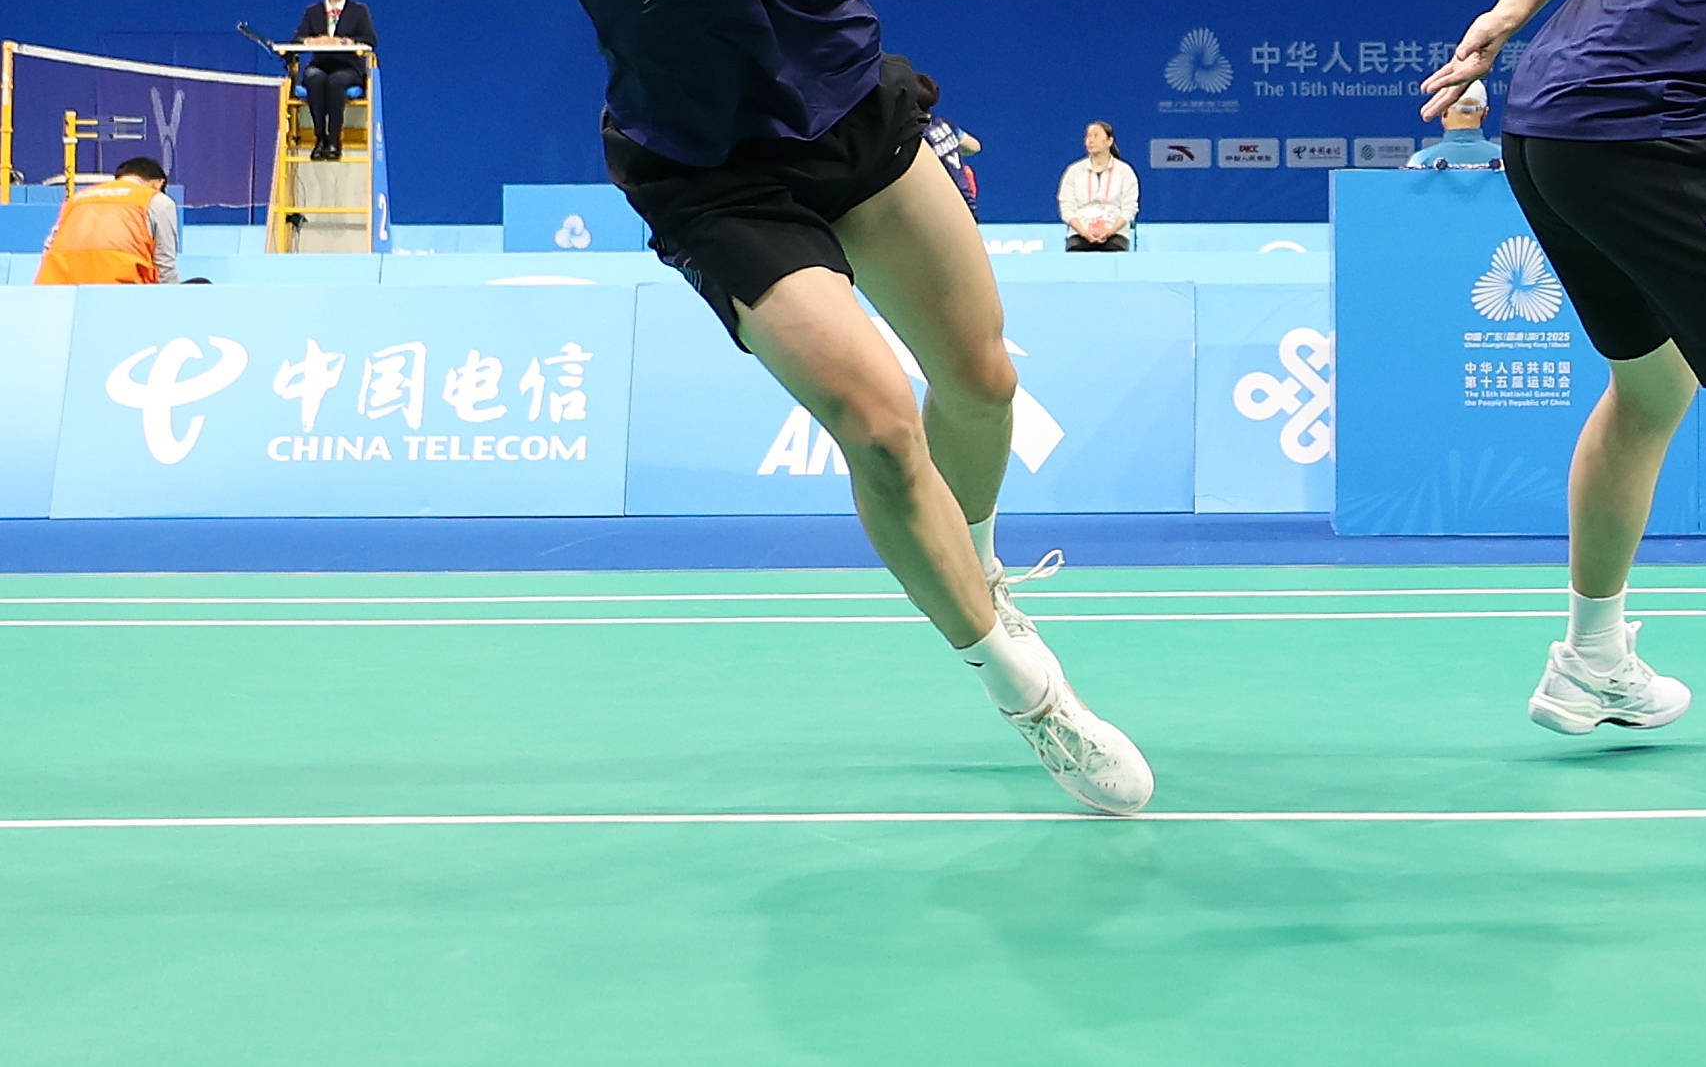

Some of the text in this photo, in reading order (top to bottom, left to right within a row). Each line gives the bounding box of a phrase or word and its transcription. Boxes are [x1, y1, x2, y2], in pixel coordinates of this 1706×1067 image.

[1254, 81, 1285, 97] The
[1291, 81, 1328, 97] 15th
[1333, 81, 1403, 97] National
[378, 192, 390, 242] 2
[1546, 332, 1571, 342] 2025
[1464, 361, 1572, 374] 中华人民共和国
[273, 338, 594, 433] 中国电信
[1464, 376, 1572, 389] 第十五届运动会
[1464, 390, 1479, 398] The
[1500, 390, 1533, 398] National
[267, 435, 588, 462] CHINA TELECOM
